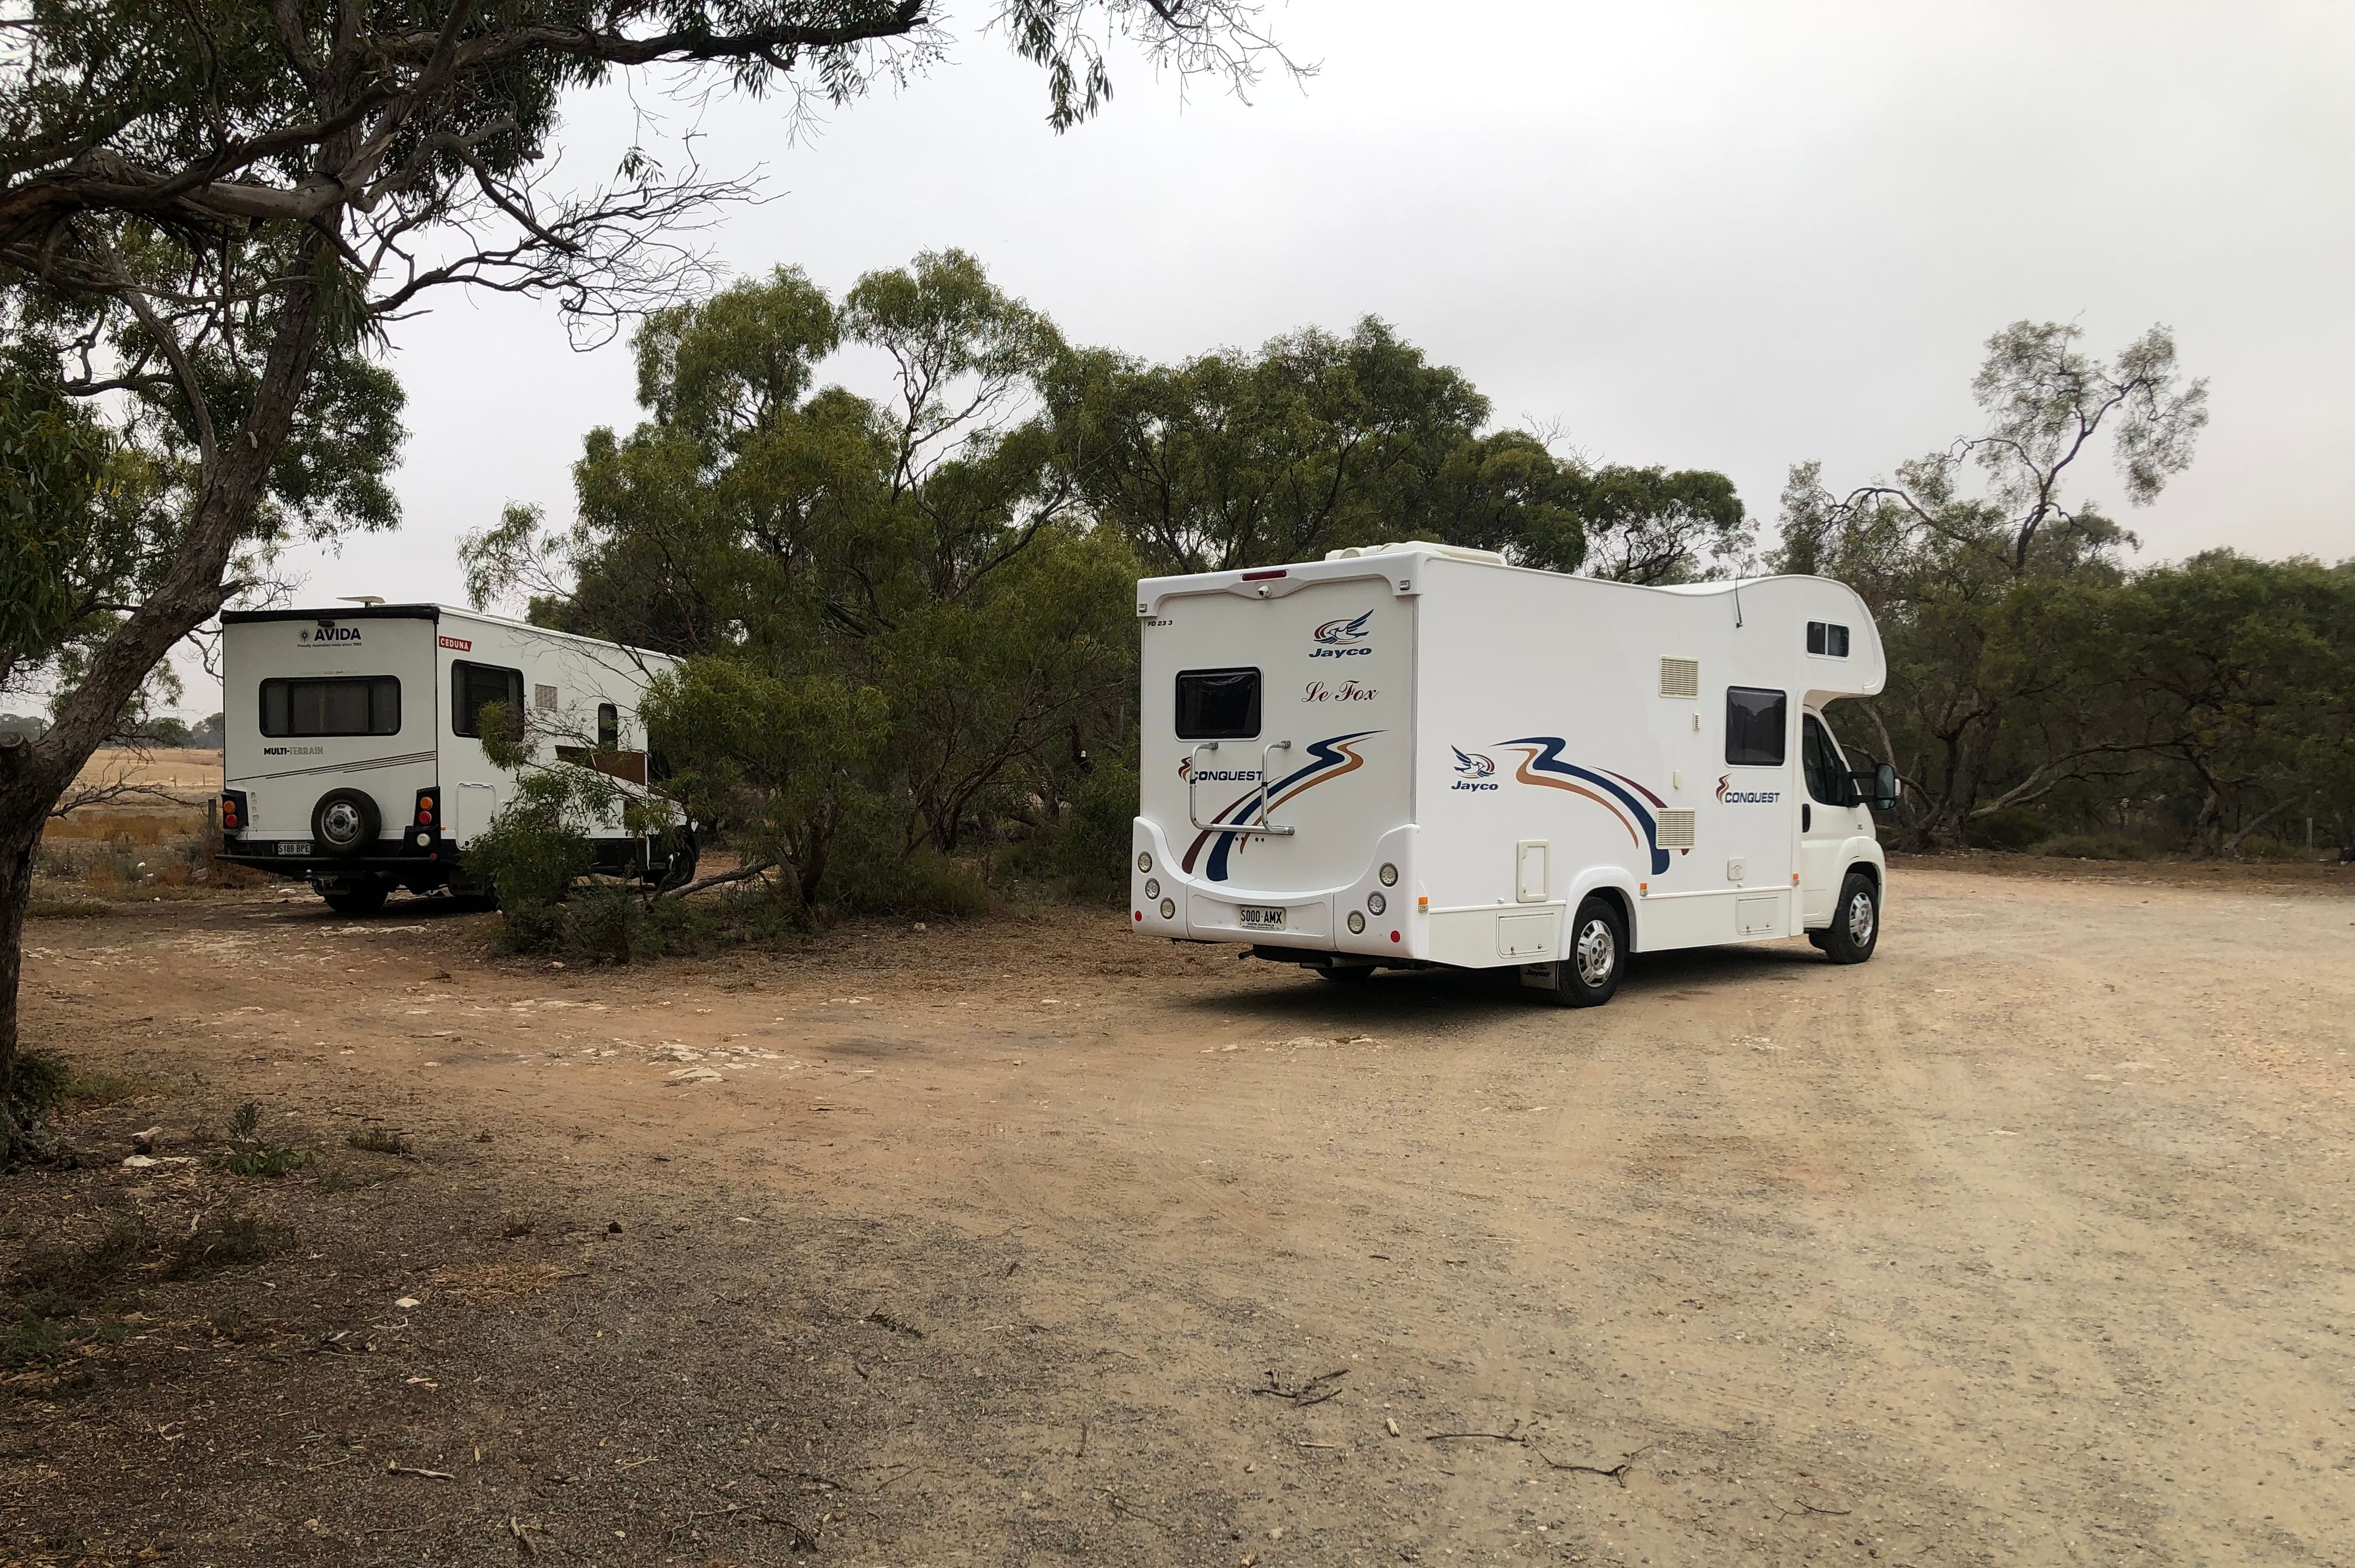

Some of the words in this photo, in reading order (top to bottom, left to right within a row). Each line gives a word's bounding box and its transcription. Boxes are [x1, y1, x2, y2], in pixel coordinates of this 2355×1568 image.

[314, 628, 361, 641] AVIDA
[440, 637, 469, 650] CEDUNA
[1308, 647, 1372, 659] Jayco
[1301, 681, 1334, 703] Le
[1334, 680, 1379, 702] Fox
[264, 746, 324, 755] MULTI-TERRAIN
[1451, 780, 1499, 792] Jayco
[1725, 792, 1780, 803] CONQUEST
[278, 844, 294, 853] S188
[296, 844, 310, 853] BPE
